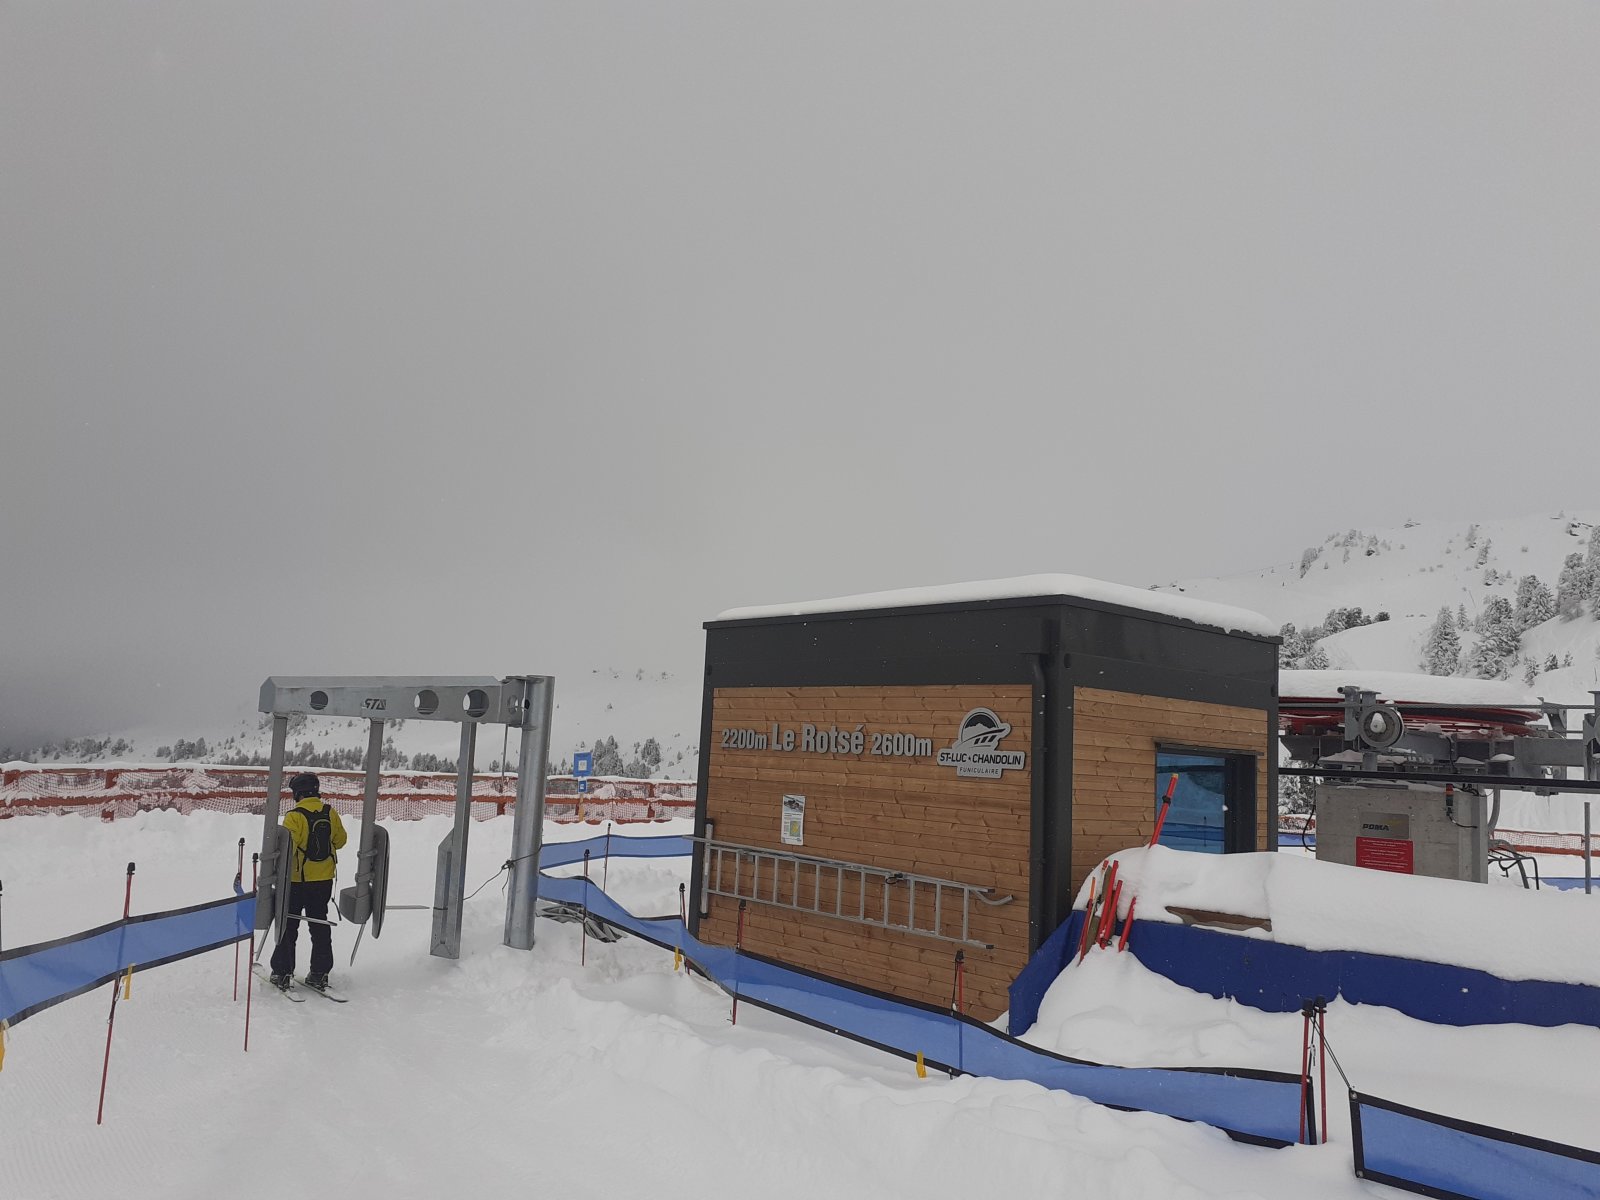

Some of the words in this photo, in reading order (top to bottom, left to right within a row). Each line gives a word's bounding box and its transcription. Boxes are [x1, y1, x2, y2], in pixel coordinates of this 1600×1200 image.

[720, 728, 767, 750] 2200m
[771, 723, 795, 751] Le
[801, 723, 865, 755] Rotsé
[871, 733, 932, 757] 2600m
[939, 752, 967, 763] ST-LUC
[972, 753, 1022, 765] CHANDOLIN
[959, 766, 999, 775] FUNICULAIRE
